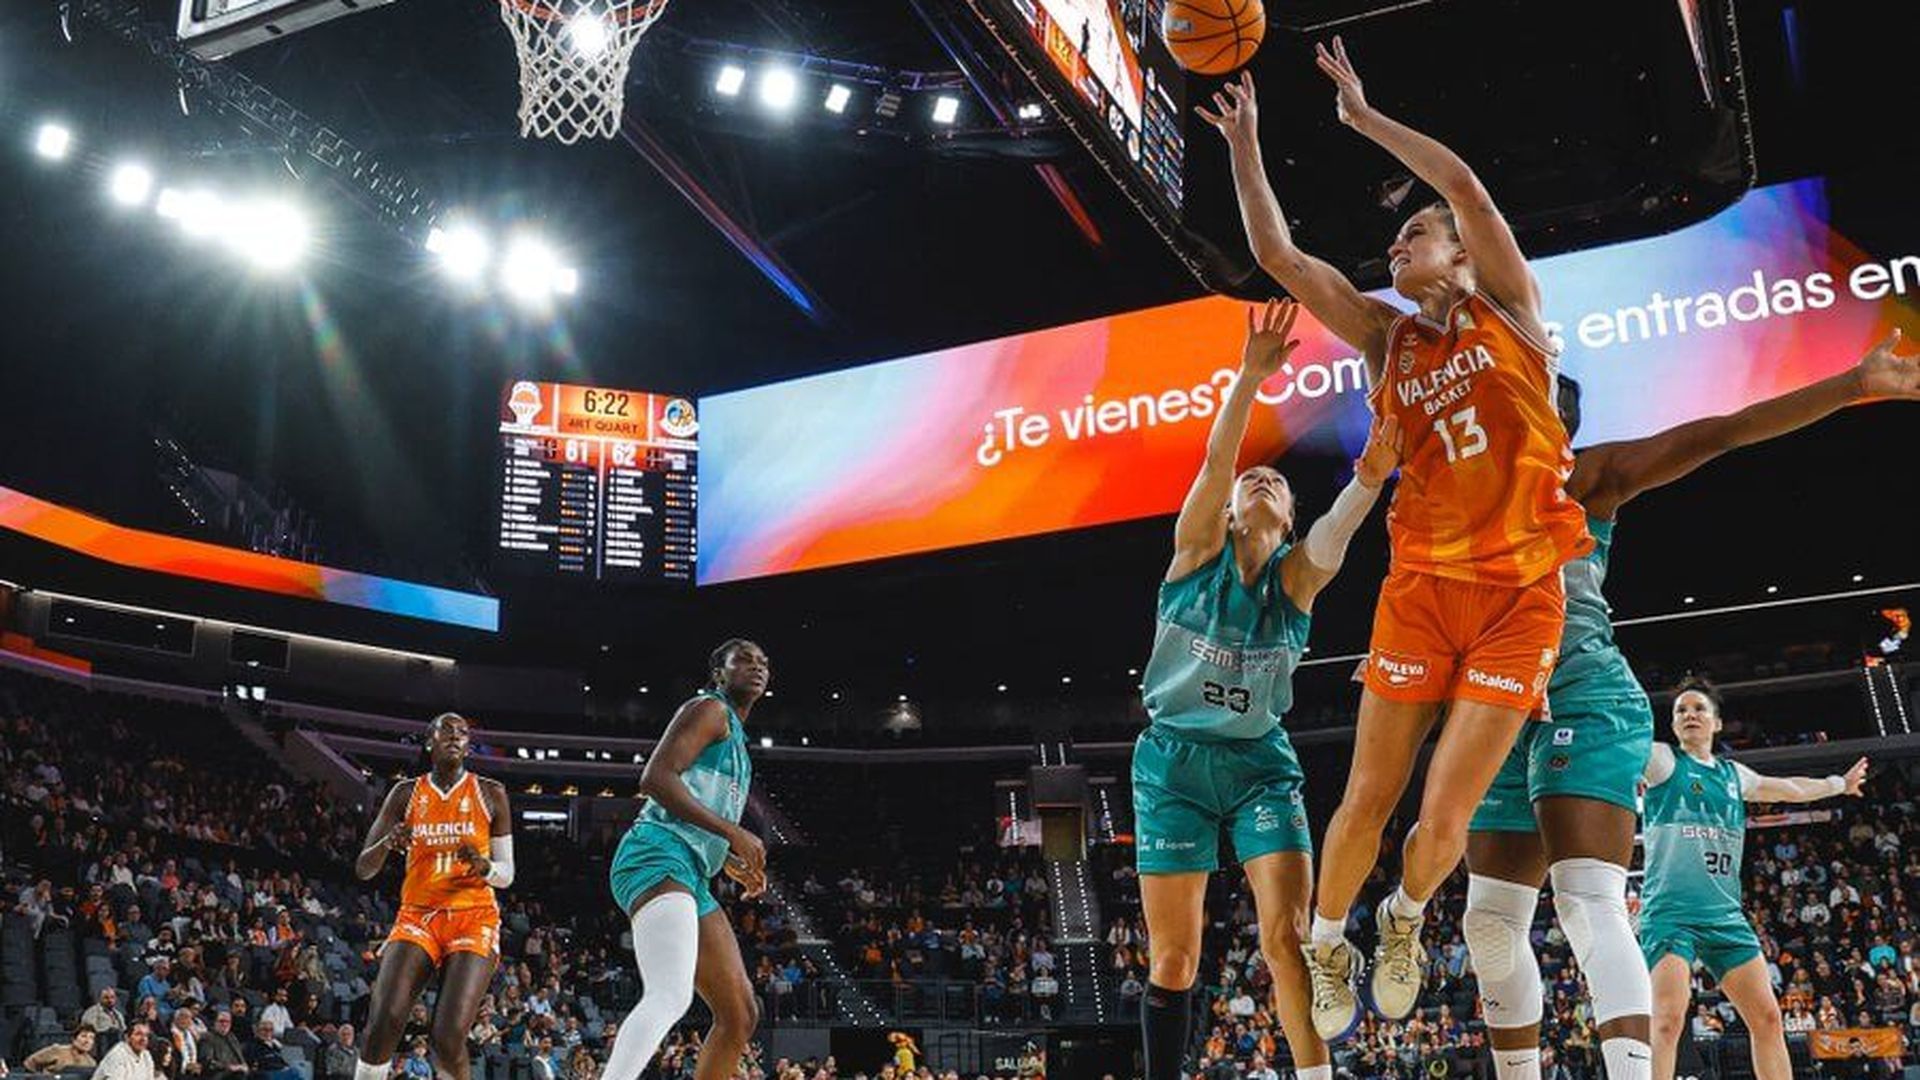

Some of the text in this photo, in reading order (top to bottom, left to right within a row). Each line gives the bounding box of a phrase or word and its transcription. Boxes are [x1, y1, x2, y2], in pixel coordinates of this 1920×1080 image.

[976, 407, 1049, 467] ¿Te
[1578, 270, 1836, 348] entradas
[1397, 345, 1496, 406] VALENCIA
[584, 390, 629, 417] 6:22
[1424, 379, 1472, 416] BASKET
[595, 421, 638, 434] QUART
[1433, 406, 1488, 463] 13
[612, 444, 637, 467] 62
[1203, 681, 1250, 714] 23
[1703, 851, 1733, 876] 20
